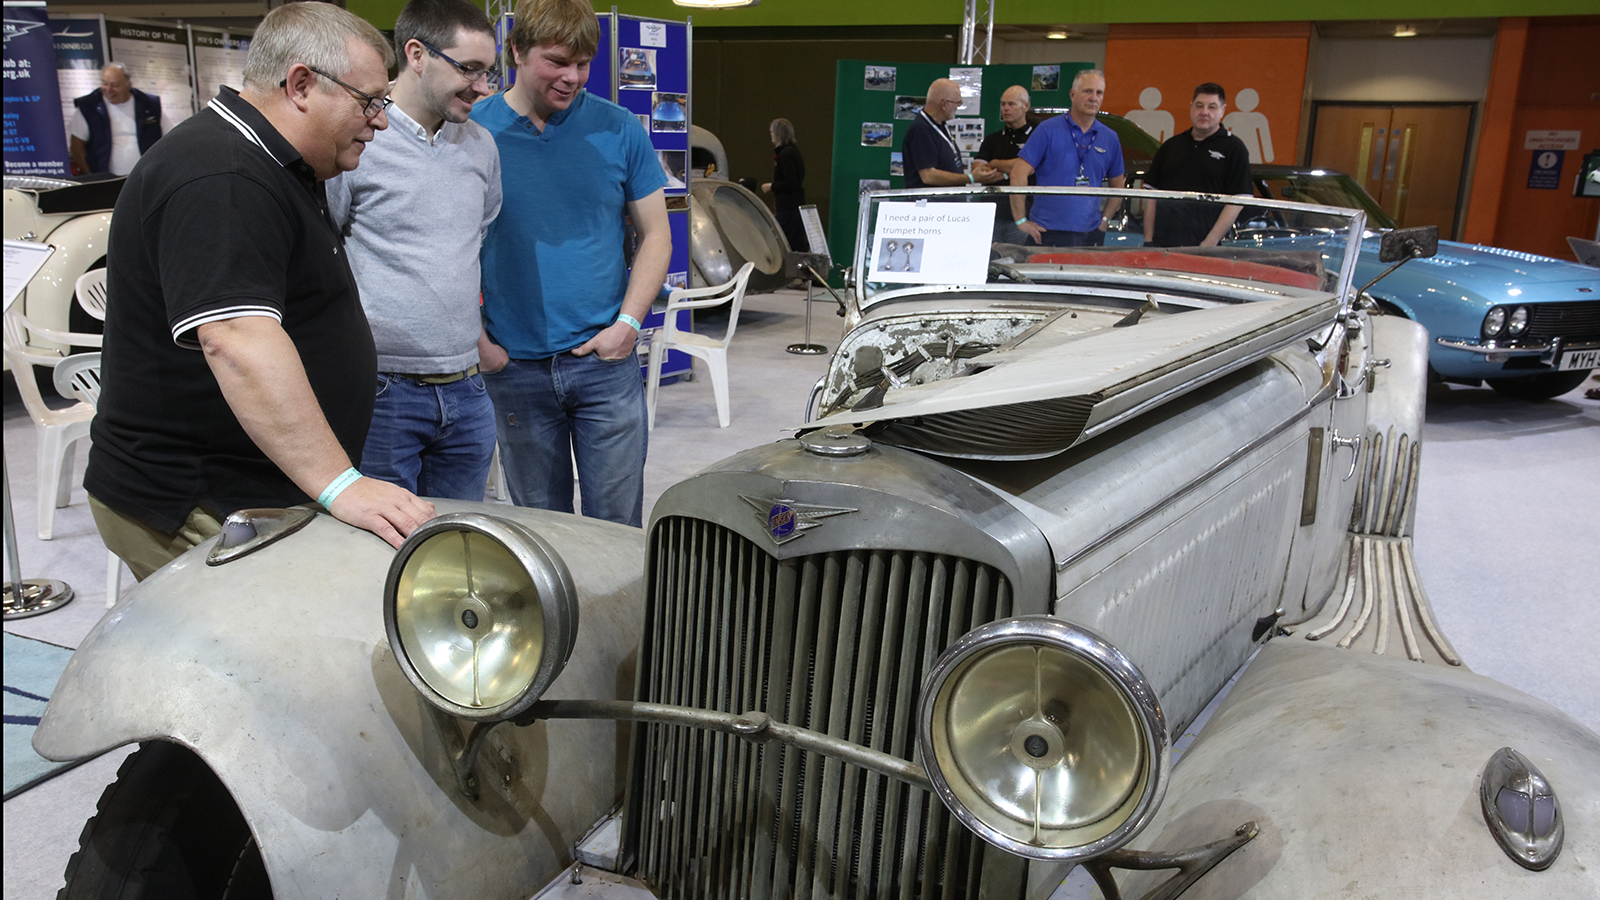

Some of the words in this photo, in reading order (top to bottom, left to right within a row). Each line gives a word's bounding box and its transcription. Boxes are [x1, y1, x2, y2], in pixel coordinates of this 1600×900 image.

[120, 28, 150, 38] HISTORY
[151, 31, 161, 39] OF
[163, 32, 176, 41] THE
[214, 38, 240, 47] OWNERS
[18, 59, 31, 68] at:
[3, 68, 31, 80] org.uk
[38, 160, 64, 168] member
[884, 214, 888, 222] I
[889, 214, 910, 222] need
[918, 215, 935, 224] pair
[936, 214, 946, 222] of
[947, 215, 970, 223] Lucas
[882, 227, 916, 236] trumpet
[918, 227, 942, 235] horns
[1568, 352, 1597, 368] MYH
